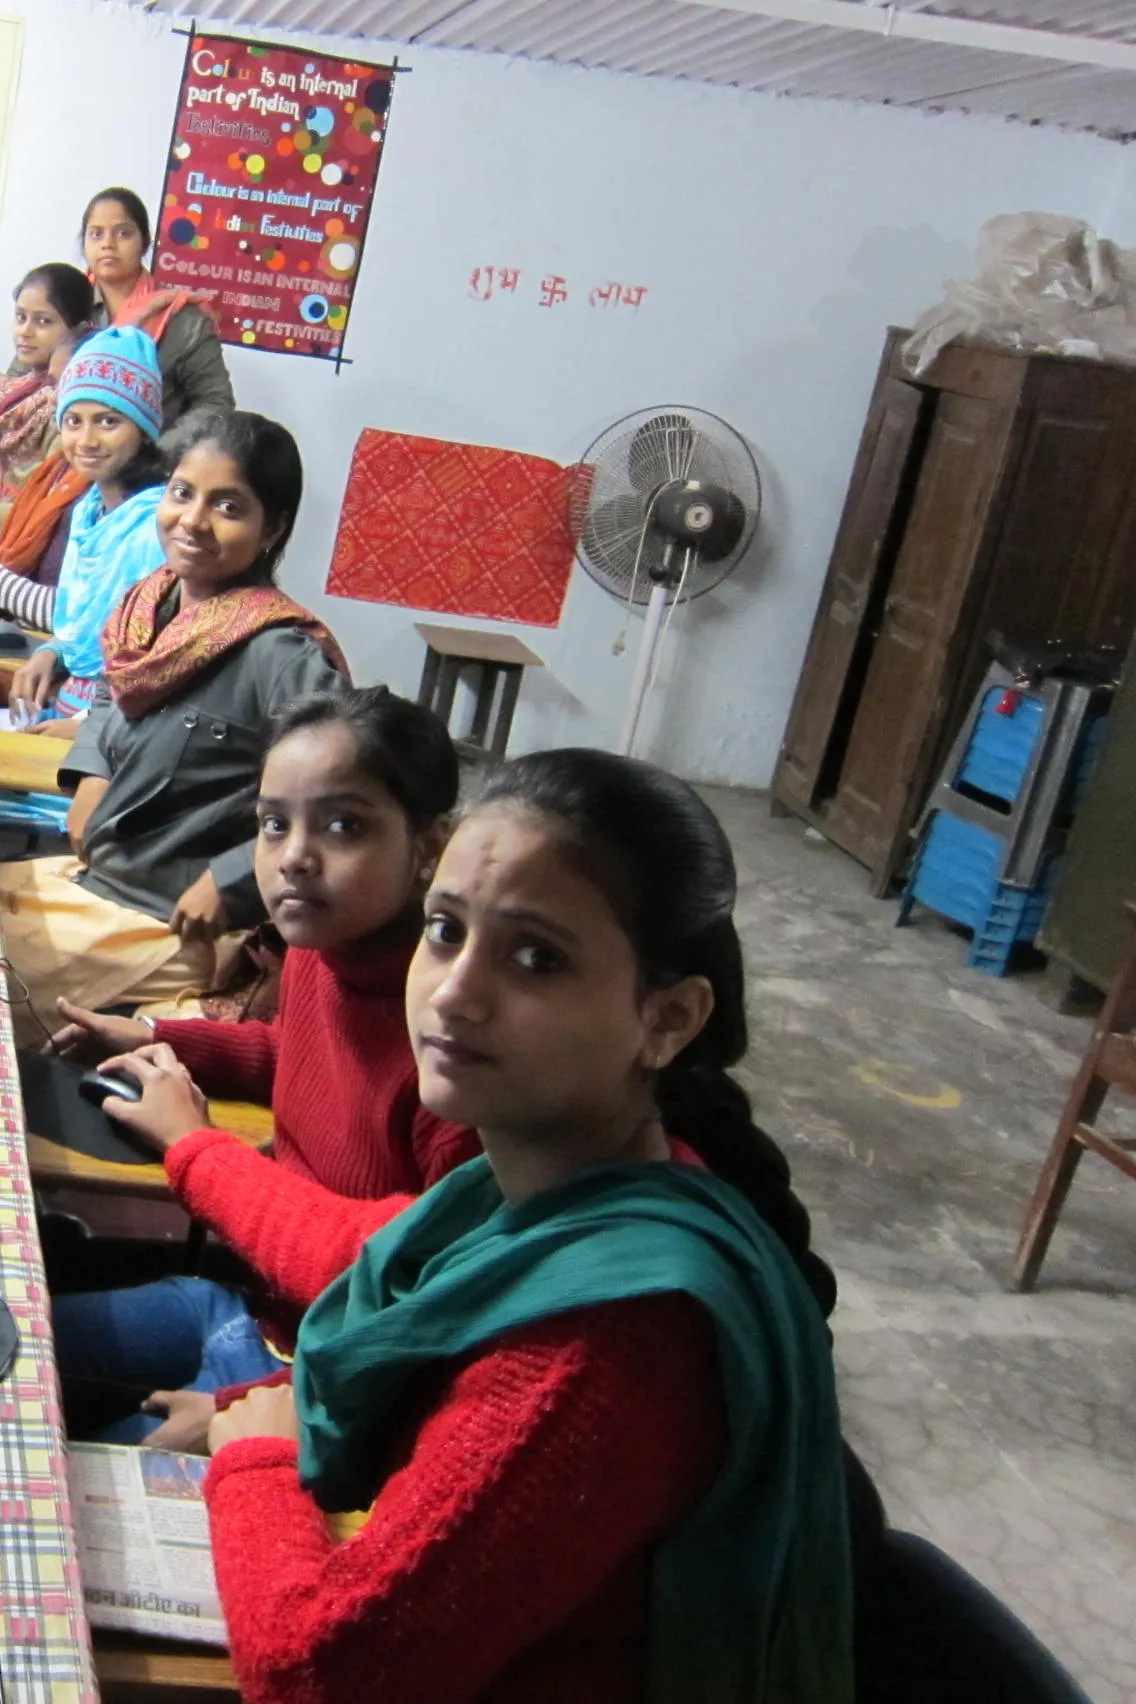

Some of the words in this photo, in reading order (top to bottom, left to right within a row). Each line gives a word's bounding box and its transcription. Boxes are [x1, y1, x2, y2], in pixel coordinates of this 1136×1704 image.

[260, 66, 275, 87] is
[278, 73, 296, 93] an
[300, 72, 358, 100] internal
[186, 84, 224, 107] part
[225, 89, 247, 111] of
[248, 88, 300, 120] Indian
[186, 171, 238, 198] Colour
[237, 186, 250, 200] is
[250, 190, 264, 202] an
[266, 188, 311, 208] internal
[311, 197, 341, 216] part
[343, 202, 363, 223] of
[260, 214, 324, 243] Festivities
[237, 269, 251, 282] IS
[253, 272, 273, 287] AN
[276, 274, 351, 297] INTERNAL
[222, 291, 280, 312] INDIAN
[255, 319, 343, 342] FESTIVITIES
